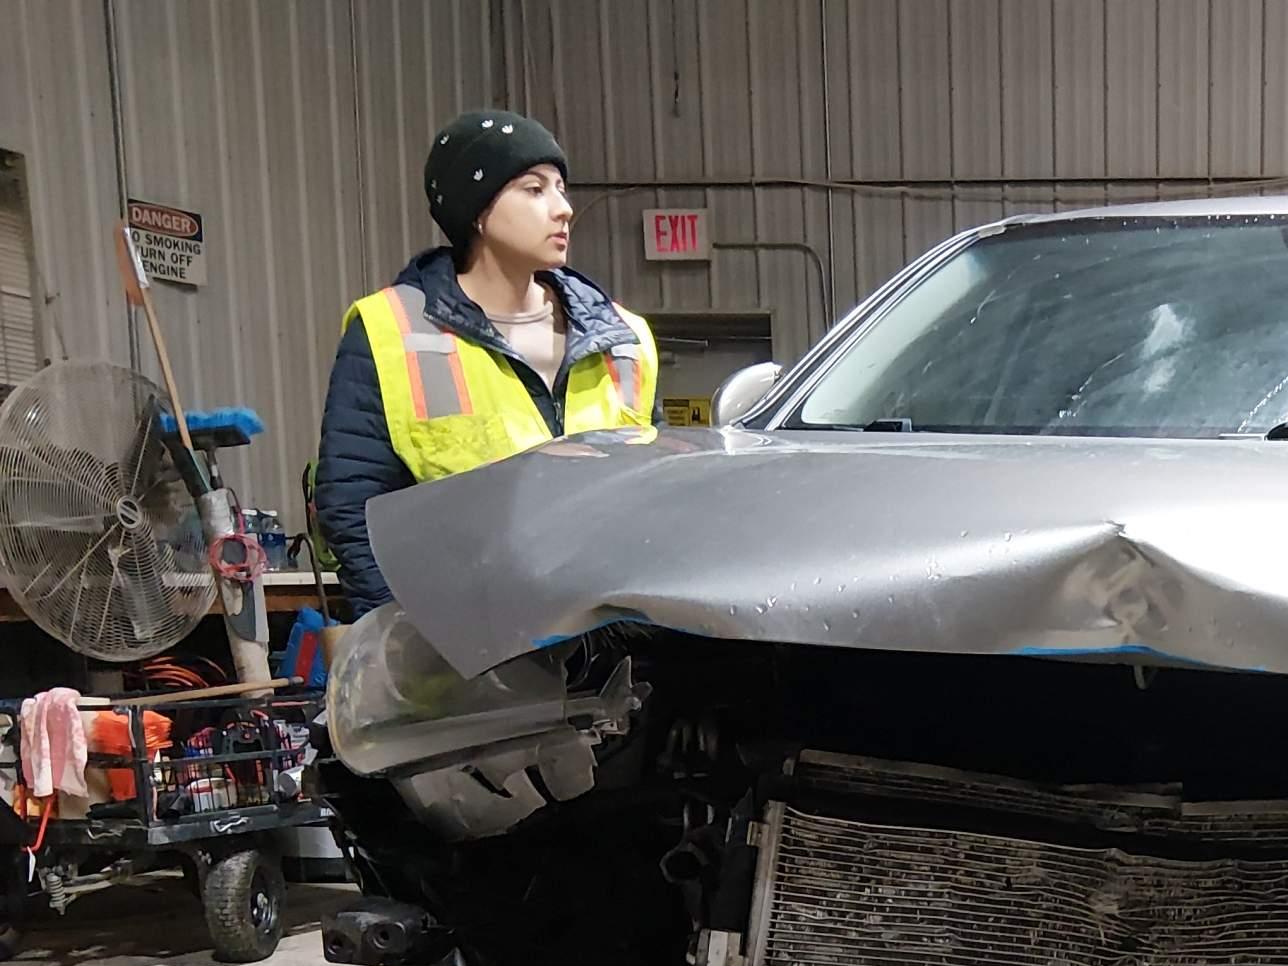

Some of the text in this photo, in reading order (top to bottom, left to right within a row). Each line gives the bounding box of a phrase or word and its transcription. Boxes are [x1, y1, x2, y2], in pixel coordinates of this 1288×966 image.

[132, 207, 192, 233] DANGER
[130, 230, 201, 255] O SMOKING
[655, 214, 698, 252] EXIT
[137, 245, 193, 267] URN OFF
[143, 260, 187, 280] ENGINE
